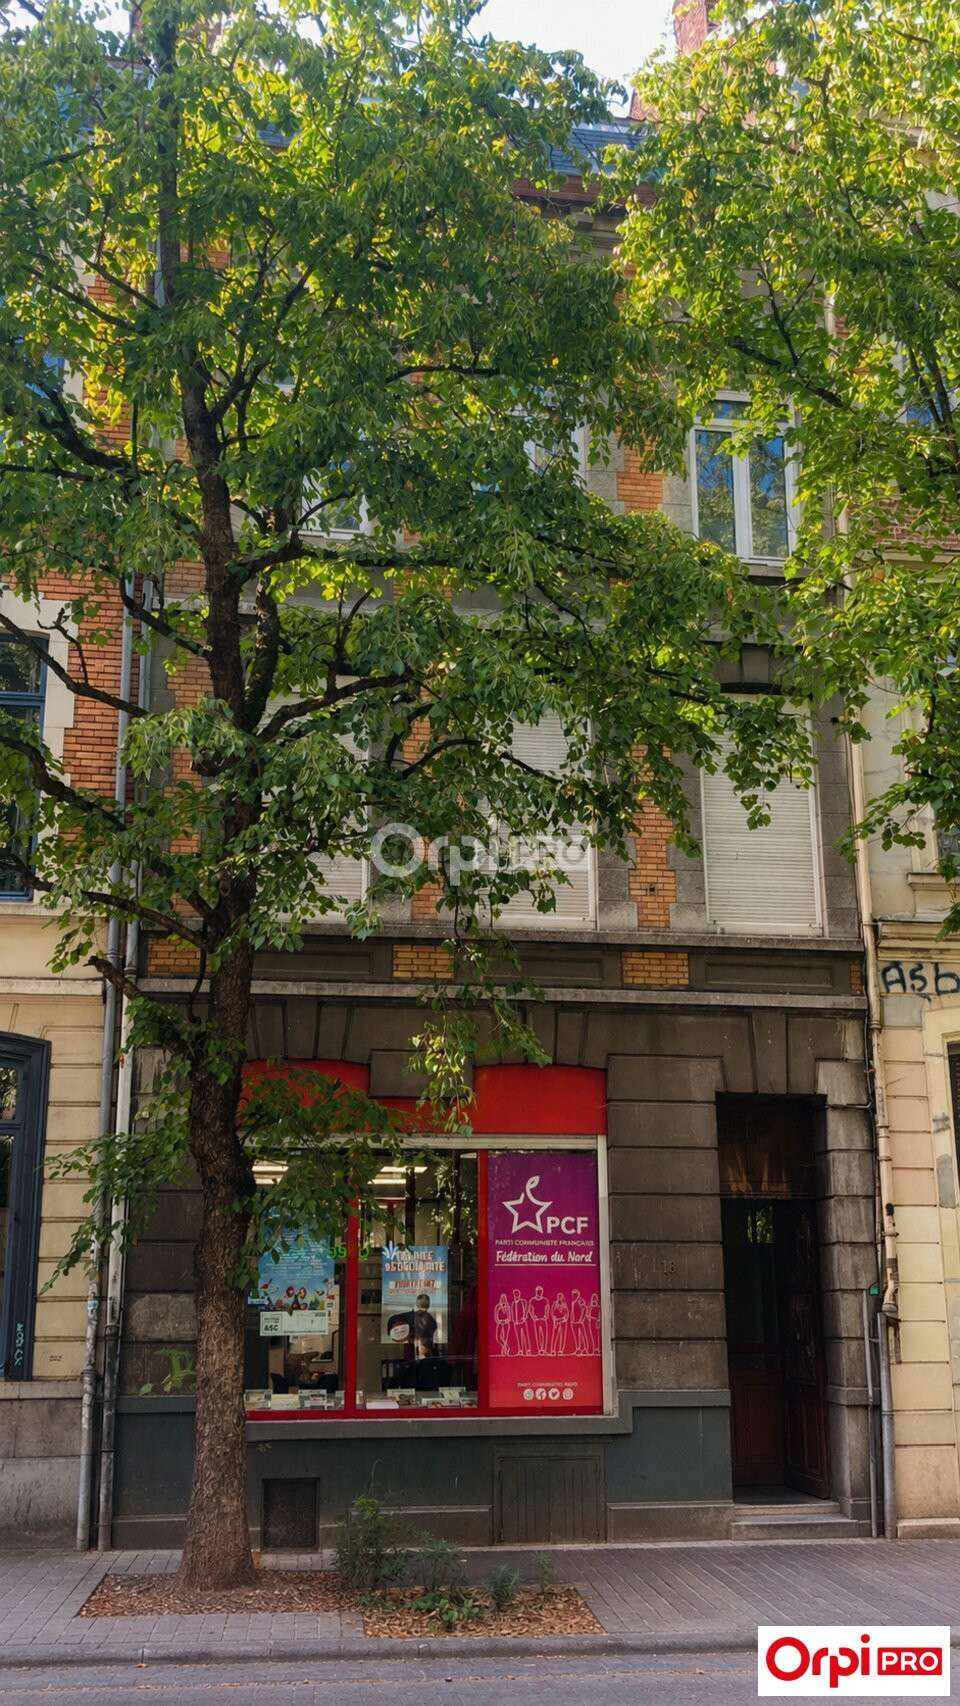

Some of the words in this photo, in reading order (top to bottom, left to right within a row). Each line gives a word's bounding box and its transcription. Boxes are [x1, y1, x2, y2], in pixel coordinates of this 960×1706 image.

[546, 1216, 588, 1234] PCF
[496, 1251, 547, 1262] Fédération
[551, 1251, 565, 1262] du
[568, 1251, 593, 1262] Nord
